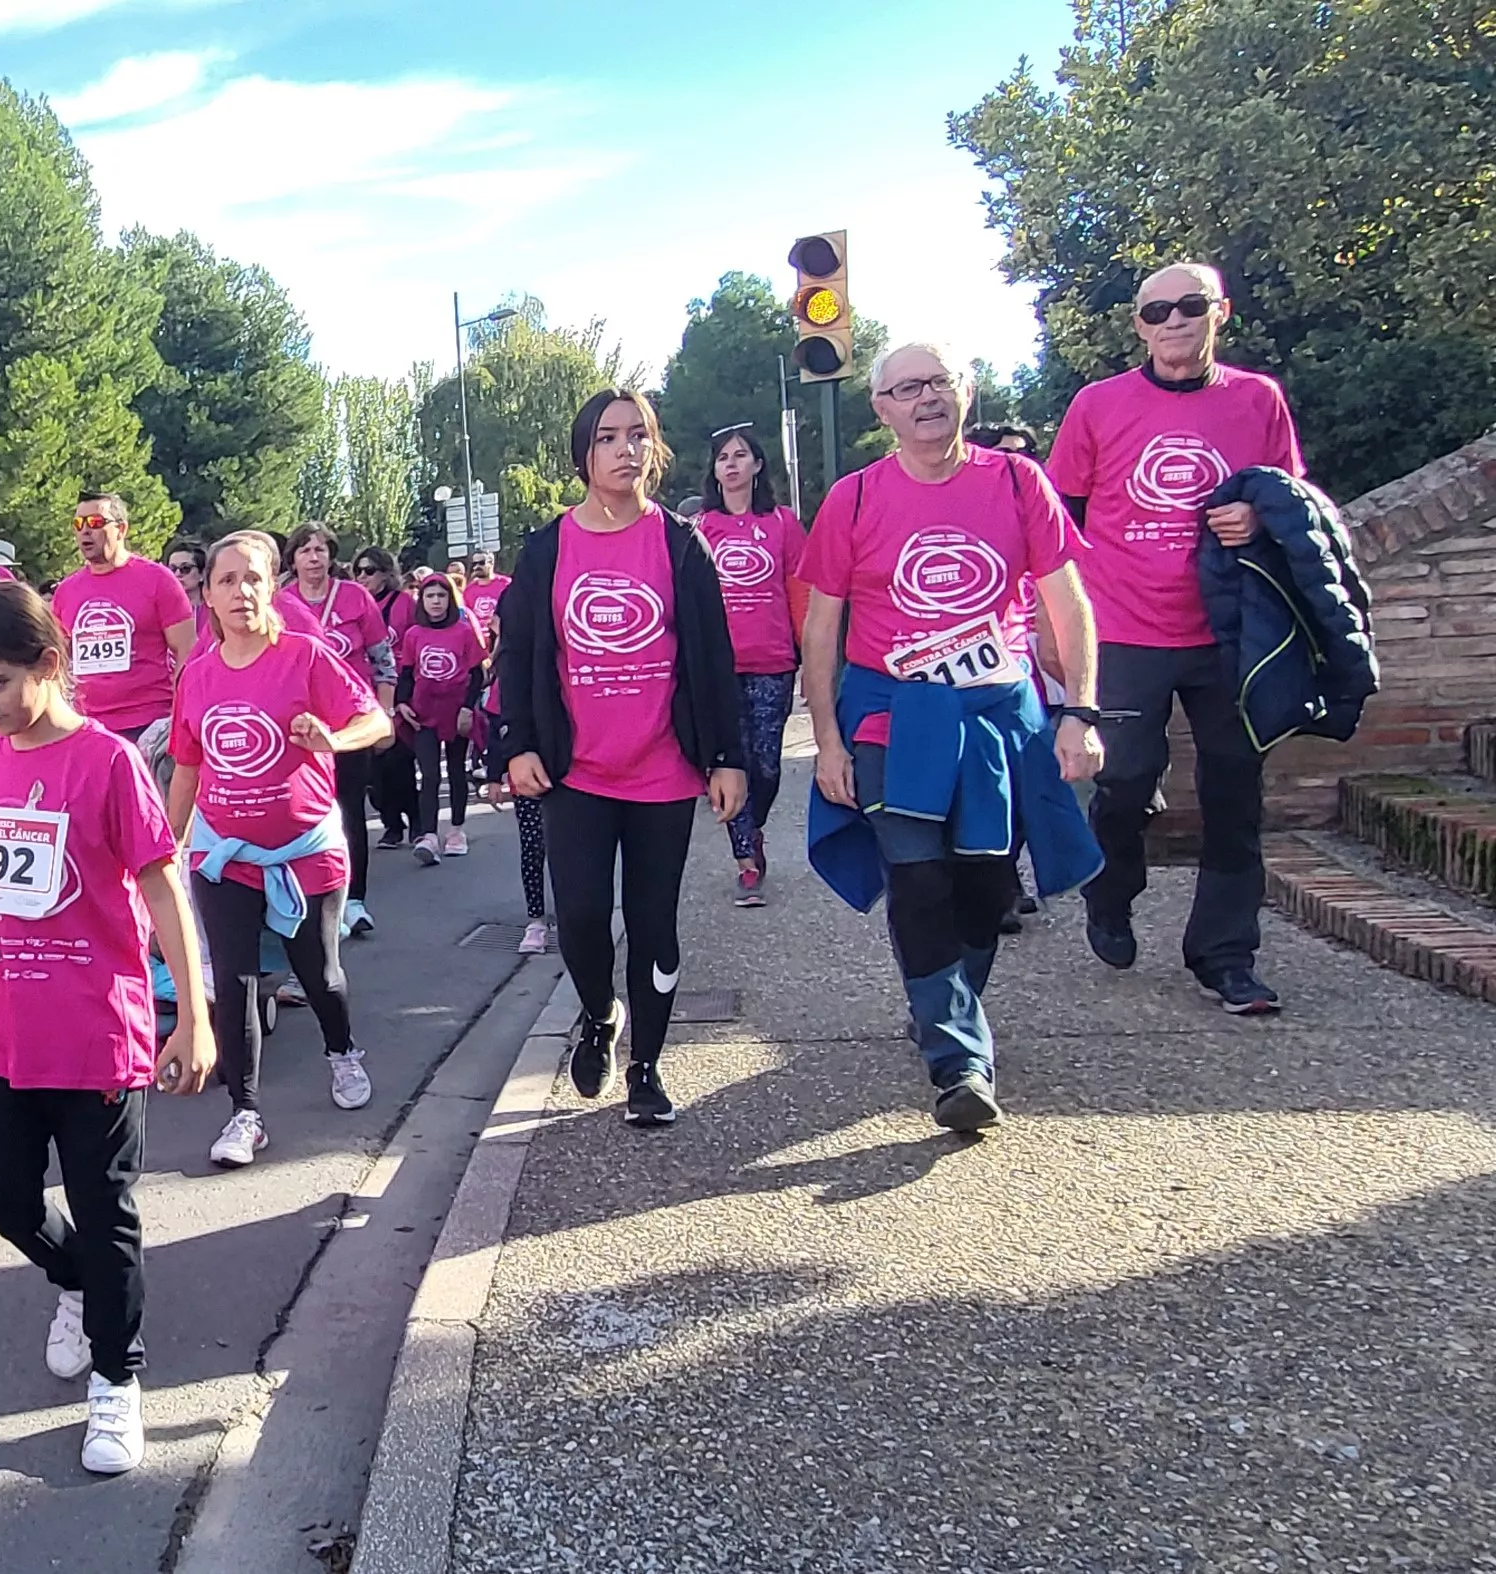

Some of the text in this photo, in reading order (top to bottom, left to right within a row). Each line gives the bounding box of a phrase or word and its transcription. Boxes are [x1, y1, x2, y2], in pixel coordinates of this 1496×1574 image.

[79, 641, 125, 661] 2495
[902, 651, 942, 670] CONTRA
[942, 646, 954, 656] EL
[8, 828, 51, 843] CÁNCER
